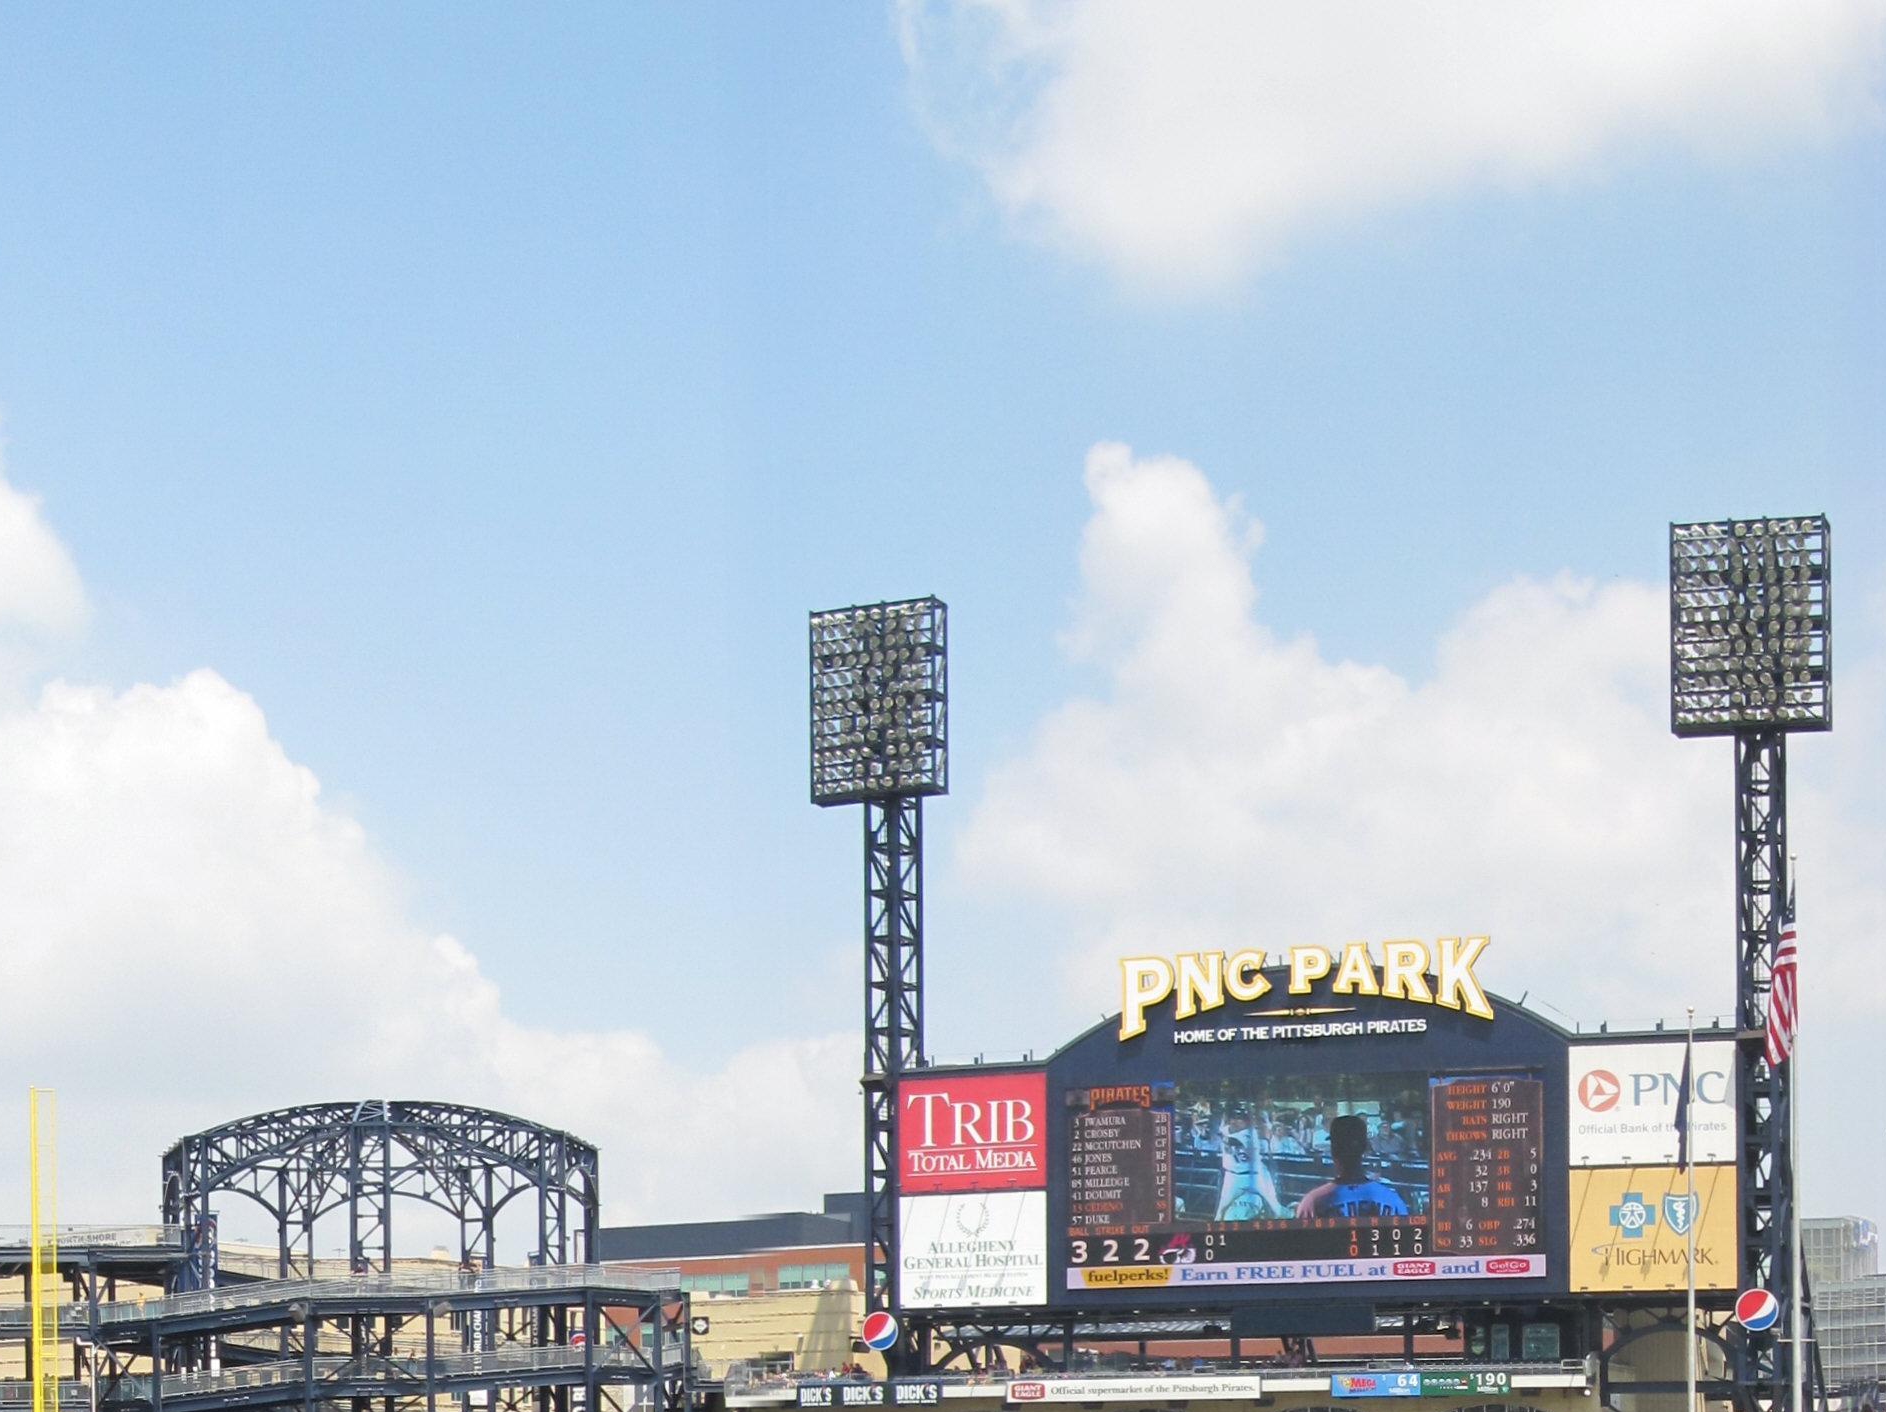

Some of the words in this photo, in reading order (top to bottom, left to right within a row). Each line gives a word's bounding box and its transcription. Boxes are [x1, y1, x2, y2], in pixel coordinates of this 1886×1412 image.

[1119, 949, 1273, 1042] PNC
[1288, 936, 1494, 1021] PARK
[1174, 1029, 1214, 1044] HOME
[1217, 1028, 1237, 1042] OF
[1241, 1026, 1269, 1041] THE
[1272, 1021, 1365, 1038] PITTSBURGH
[1366, 1019, 1427, 1034] PIRATES
[1447, 1084, 1487, 1095] HEIGHT
[1629, 1071, 1726, 1106] PNC
[1089, 1086, 1151, 1111] PIRATES
[1446, 1100, 1487, 1111] WEIGHT
[1492, 1098, 1511, 1109] 190
[907, 1092, 1035, 1147] TRIB
[1085, 1116, 1126, 1126] IWAMURA
[1462, 1115, 1487, 1126] BATS
[1492, 1112, 1528, 1124] RIGHT
[1085, 1129, 1120, 1139] CROSBY
[1492, 1128, 1528, 1140] RIGHT
[1578, 1124, 1617, 1135] Official
[1620, 1123, 1648, 1134] Bank
[1651, 1122, 1663, 1133] of
[908, 1151, 971, 1172] TOTAL
[976, 1149, 1037, 1169] MEDIA
[1084, 1153, 1112, 1163] JONES
[1470, 1150, 1492, 1161] .234
[1085, 1177, 1129, 1188] MILLEDGE
[1085, 1190, 1122, 1200] DOUMIT
[1085, 1215, 1110, 1225] DUKE
[1513, 1219, 1536, 1230] .274
[1132, 1224, 1150, 1234] OUT
[928, 1240, 1016, 1254] ALLEGHENY
[1071, 1240, 1088, 1263] 3
[1103, 1239, 1119, 1262] 2
[1134, 1238, 1150, 1261] 2
[904, 1256, 971, 1270] GENERAL
[976, 1254, 1043, 1268] HOSPITAL
[1442, 1261, 1480, 1275] and
[1088, 1268, 1168, 1284] fuelperks!
[1181, 1268, 1229, 1282] Earn
[1236, 1266, 1294, 1280] FREE
[1301, 1264, 1362, 1278] FUEL
[1368, 1263, 1387, 1276] at
[913, 1286, 962, 1300] SPORTS
[967, 1285, 1034, 1298] MEDICINE
[1397, 1374, 1418, 1387] 64
[800, 1385, 832, 1403] DICK'S
[843, 1385, 883, 1402] DICK'S
[896, 1384, 938, 1400] DICK'S
[1051, 1386, 1085, 1395] Official
[1088, 1384, 1142, 1397] supermarket
[1145, 1384, 1155, 1393] of
[1156, 1384, 1170, 1393] the
[1173, 1383, 1219, 1394] Pittsburgh
